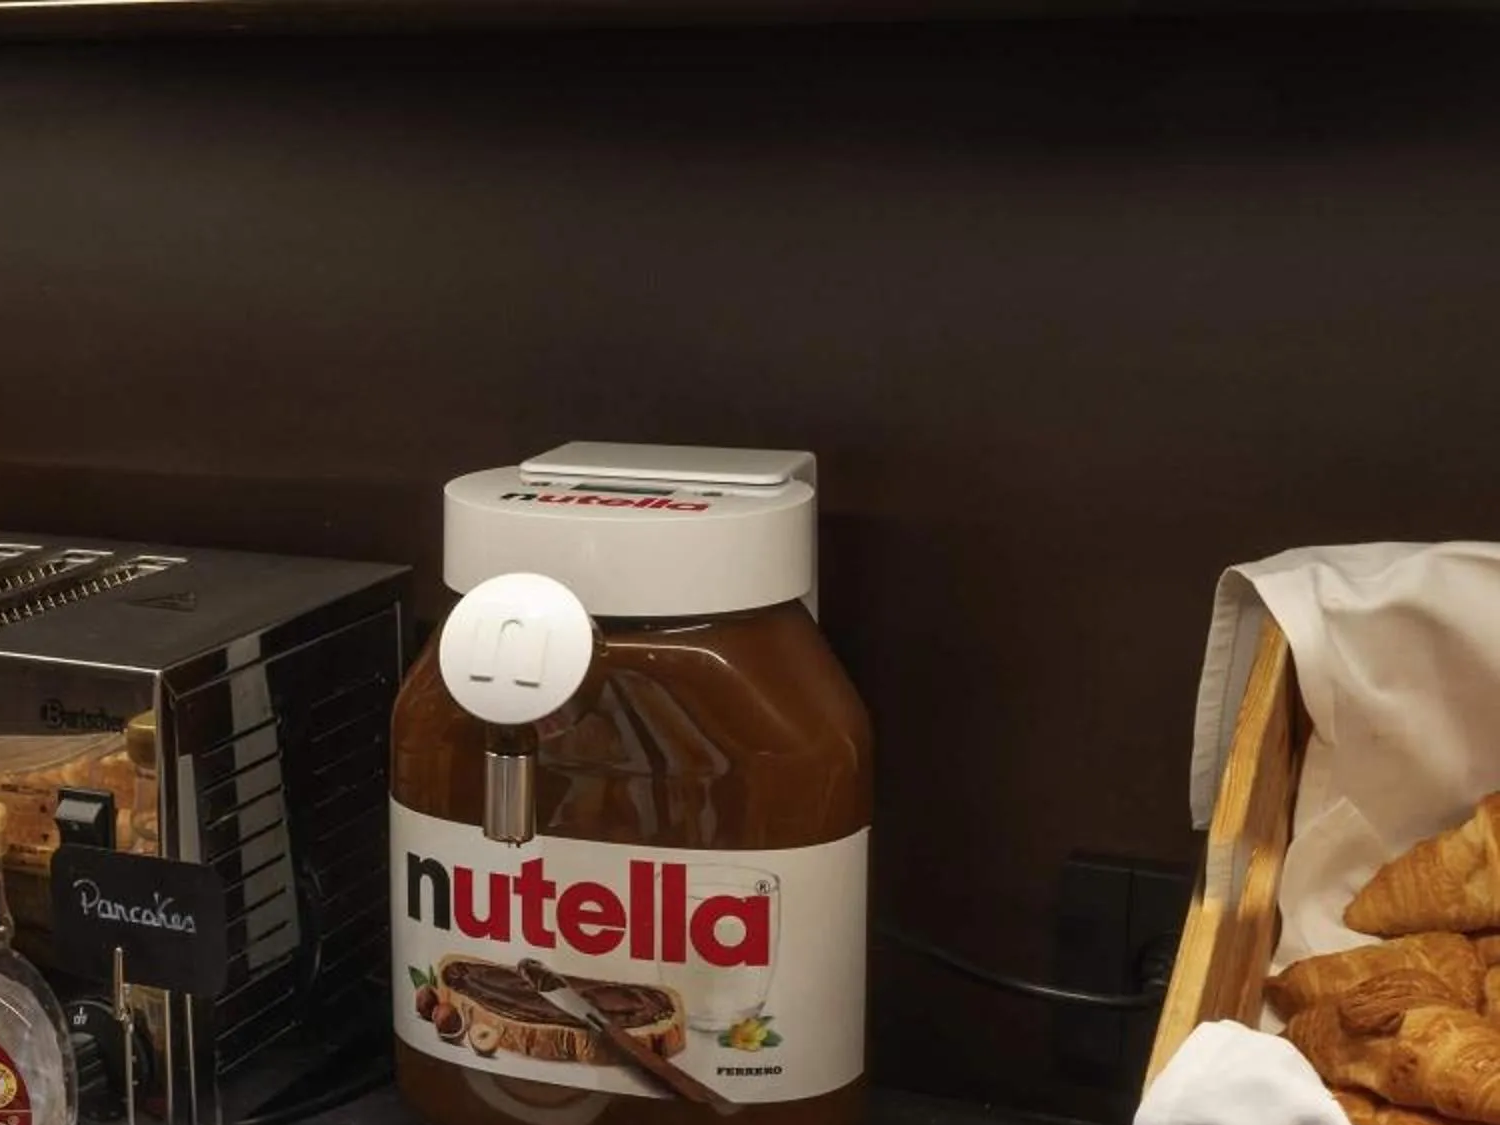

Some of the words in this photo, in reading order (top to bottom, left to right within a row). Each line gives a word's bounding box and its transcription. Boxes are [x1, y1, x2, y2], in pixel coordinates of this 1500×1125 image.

[500, 491, 711, 512] nutella
[73, 878, 197, 933] Pancakes
[407, 851, 771, 967] nutella
[716, 1065, 783, 1077] FERRERO
